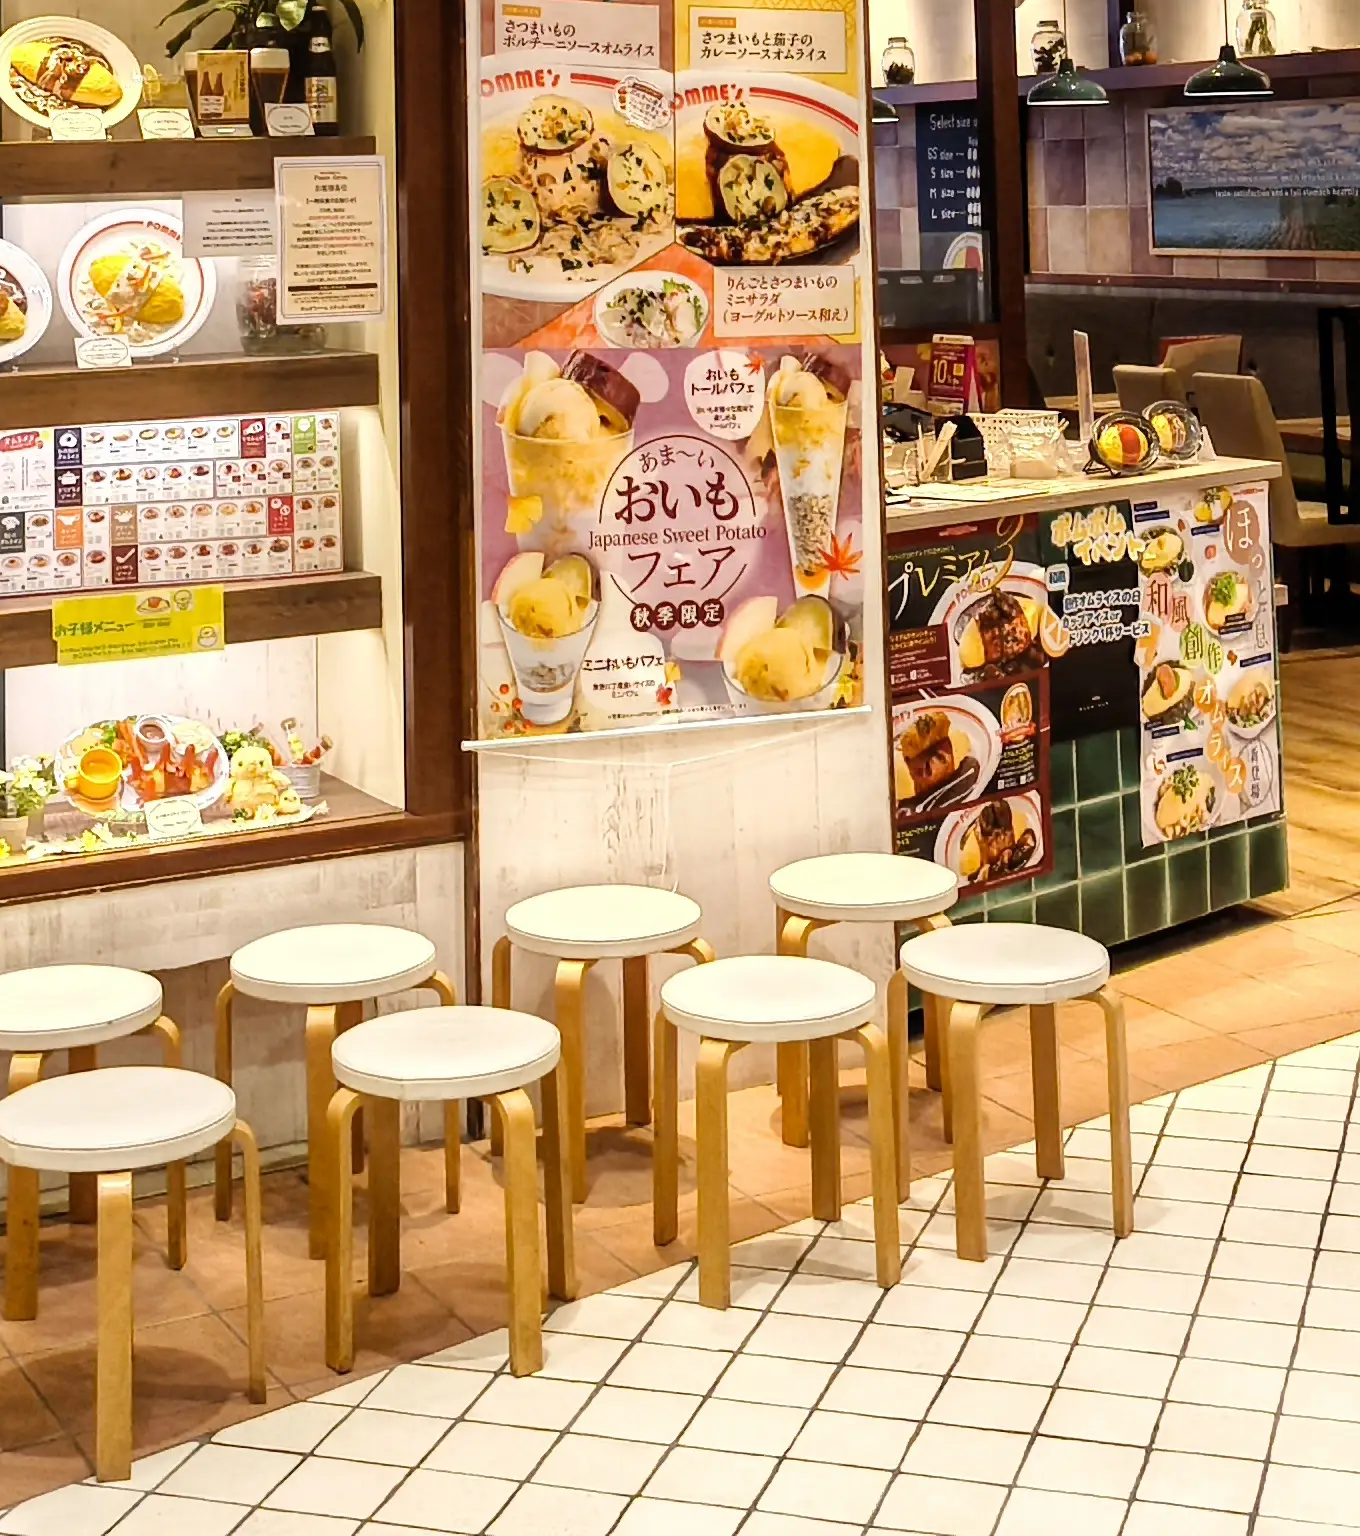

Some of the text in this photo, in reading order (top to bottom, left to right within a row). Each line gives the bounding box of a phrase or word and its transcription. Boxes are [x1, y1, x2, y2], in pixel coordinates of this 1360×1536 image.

[504, 19, 576, 37] さつまいもの
[502, 34, 656, 57] ポルチーニソースオムライス
[701, 30, 814, 48] さつまいもと茄子の
[700, 46, 828, 62] カレーソースオムライス
[929, 114, 955, 131] Select
[927, 146, 954, 161] SS size
[930, 166, 955, 179] S size
[941, 187, 955, 199] size
[931, 207, 938, 220] L
[726, 275, 838, 290] りんごとさつまいもの
[725, 292, 781, 307] ミニサラダ
[705, 368, 740, 382] おいも
[691, 382, 756, 396] トールパフェ
[614, 471, 740, 525] おいも
[1051, 505, 1127, 548] ポムポム
[588, 523, 768, 552] Japanese Sweet Potato
[1073, 530, 1146, 566] イベント
[627, 545, 737, 593] フェア
[887, 549, 998, 621] プレミアム
[631, 600, 725, 630] 秋季限定
[54, 620, 136, 638] お子様メニュー
[1069, 622, 1151, 647] ドリンク1杯サービス
[581, 655, 665, 672] ミニおいもパフェ
[1250, 745, 1261, 799] 新登場
